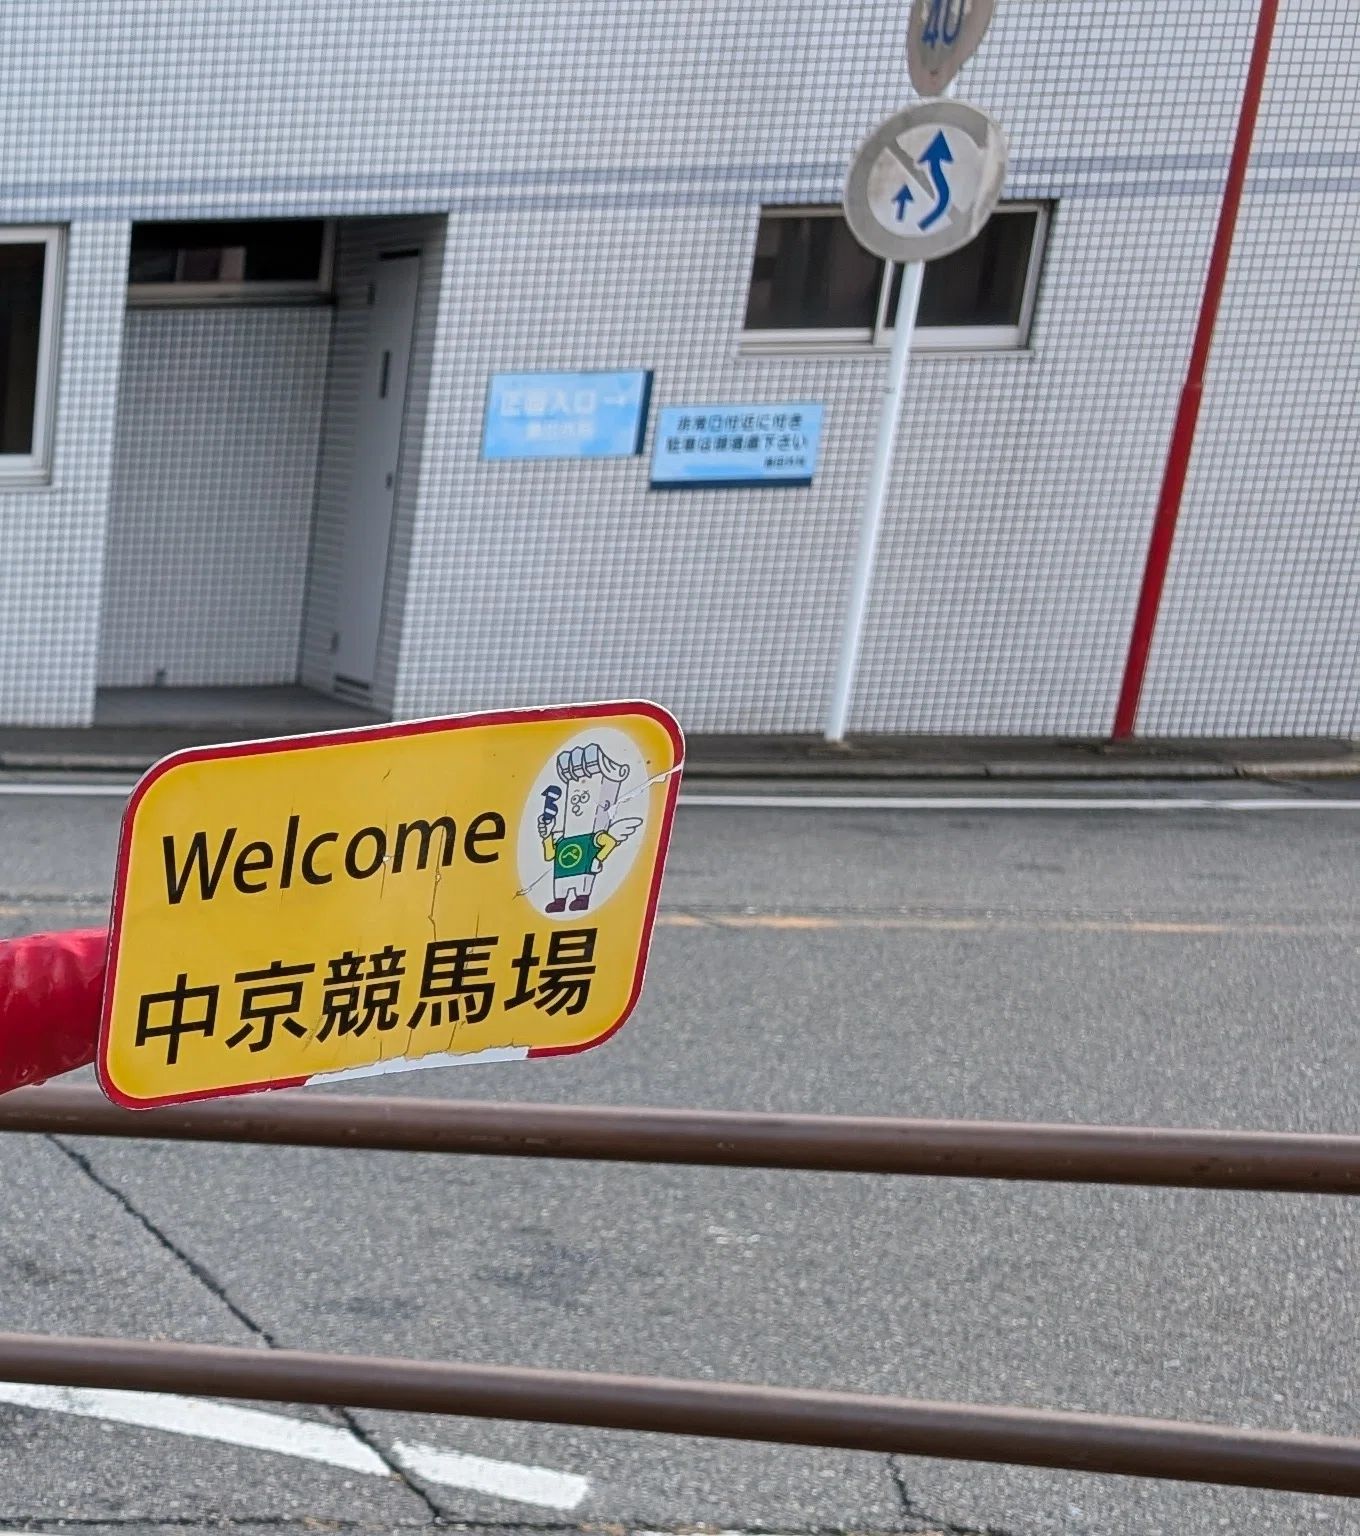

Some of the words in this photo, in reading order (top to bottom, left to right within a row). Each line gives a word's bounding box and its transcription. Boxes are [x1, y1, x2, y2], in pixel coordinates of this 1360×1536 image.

[162, 810, 506, 906] Welcome
[134, 927, 599, 1066] 中京競馬場
